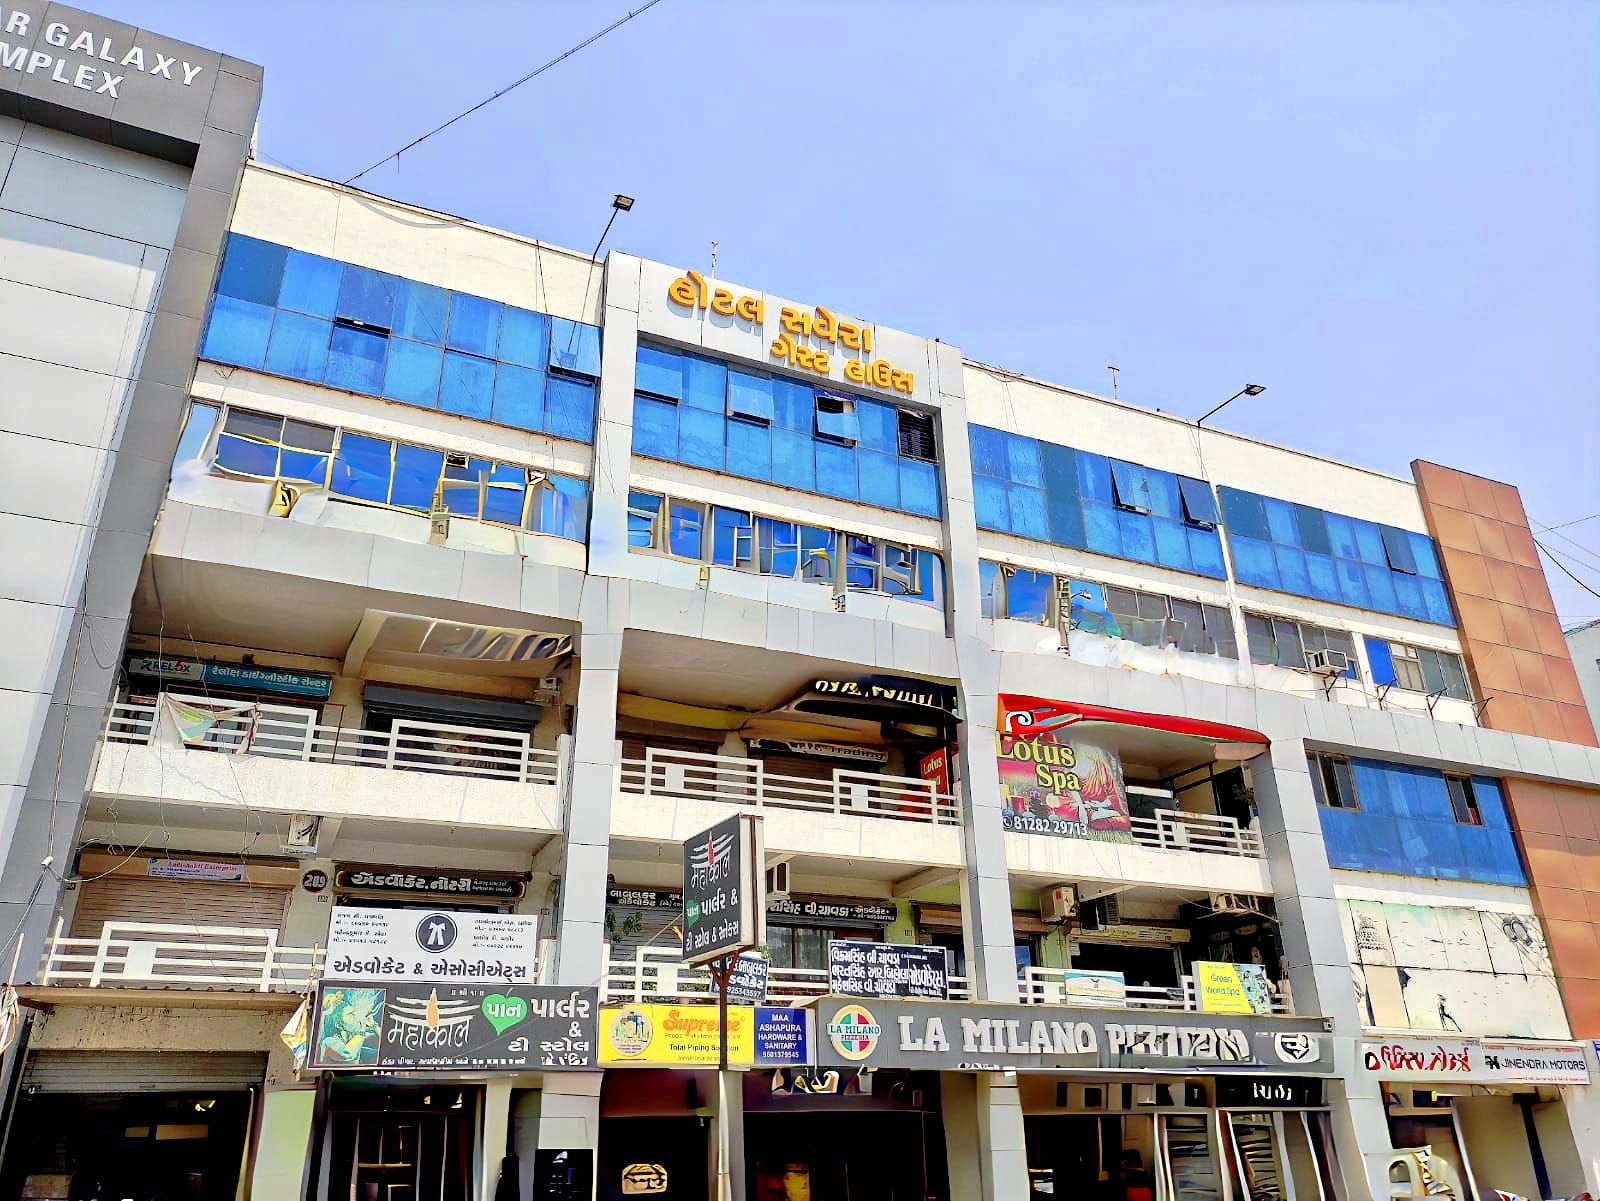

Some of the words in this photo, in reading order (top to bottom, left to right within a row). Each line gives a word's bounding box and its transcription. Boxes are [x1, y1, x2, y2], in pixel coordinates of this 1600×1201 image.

[0, 9, 31, 37] R
[45, 22, 203, 86] GALAXY
[668, 270, 764, 325] હોટલ
[780, 306, 873, 353] સવેરા
[771, 333, 832, 373] ગેસ્ટ
[995, 731, 1077, 768] Lotus
[923, 756, 943, 775] Lotus
[1036, 762, 1082, 796] Spa
[1014, 816, 1051, 832] 81282
[1053, 820, 1088, 836] 29713
[701, 887, 727, 916] પાર્લર
[730, 888, 738, 906] &
[333, 955, 405, 975] એડવોકેટ
[413, 963, 424, 975] &
[487, 1003, 521, 1019] પાન
[531, 991, 590, 1019] પાર્લર
[759, 1023, 802, 1033] ASHAPURA
[771, 1014, 790, 1022] MAA
[387, 1016, 474, 1051] महाकाल
[568, 1021, 583, 1038] &
[758, 1033, 797, 1041] HARDWARE
[830, 1025, 842, 1034] LA
[845, 1025, 880, 1035] MILANO
[897, 1016, 950, 1052] LA
[960, 1018, 1098, 1054] MILANO
[508, 1037, 530, 1052] ટી
[540, 1037, 590, 1052] સ્ટોલ
[688, 1044, 710, 1053] Piping
[764, 1042, 797, 1050] SANITARY
[1501, 1058, 1548, 1070] JINENDRA
[1549, 1059, 1586, 1071] MOTORS
